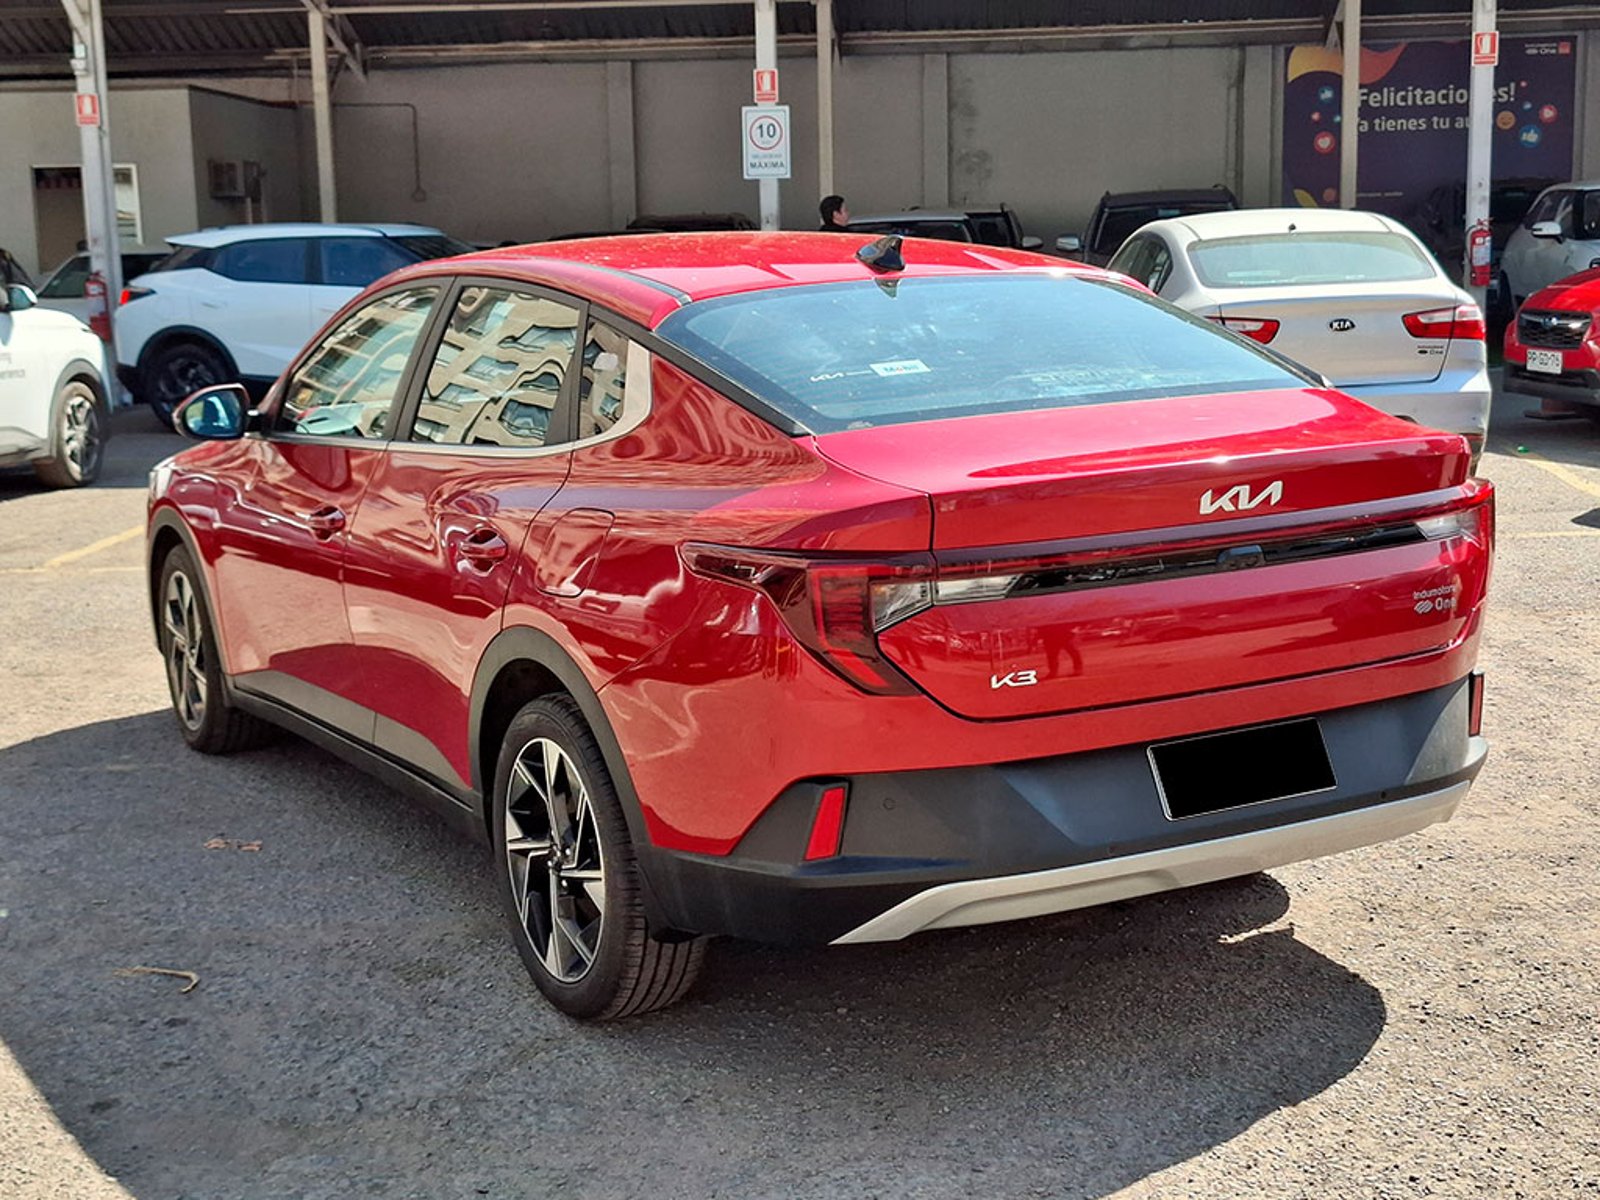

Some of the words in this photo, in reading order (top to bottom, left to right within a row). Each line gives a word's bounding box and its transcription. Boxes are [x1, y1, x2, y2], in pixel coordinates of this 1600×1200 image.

[1358, 82, 1516, 107] Felicitacios!
[756, 123, 776, 138] 10
[1374, 117, 1426, 131] tienes
[1431, 116, 1450, 129] tu
[1332, 321, 1352, 330] KIA
[1199, 480, 1283, 515] KIA
[990, 669, 1038, 690] K3
